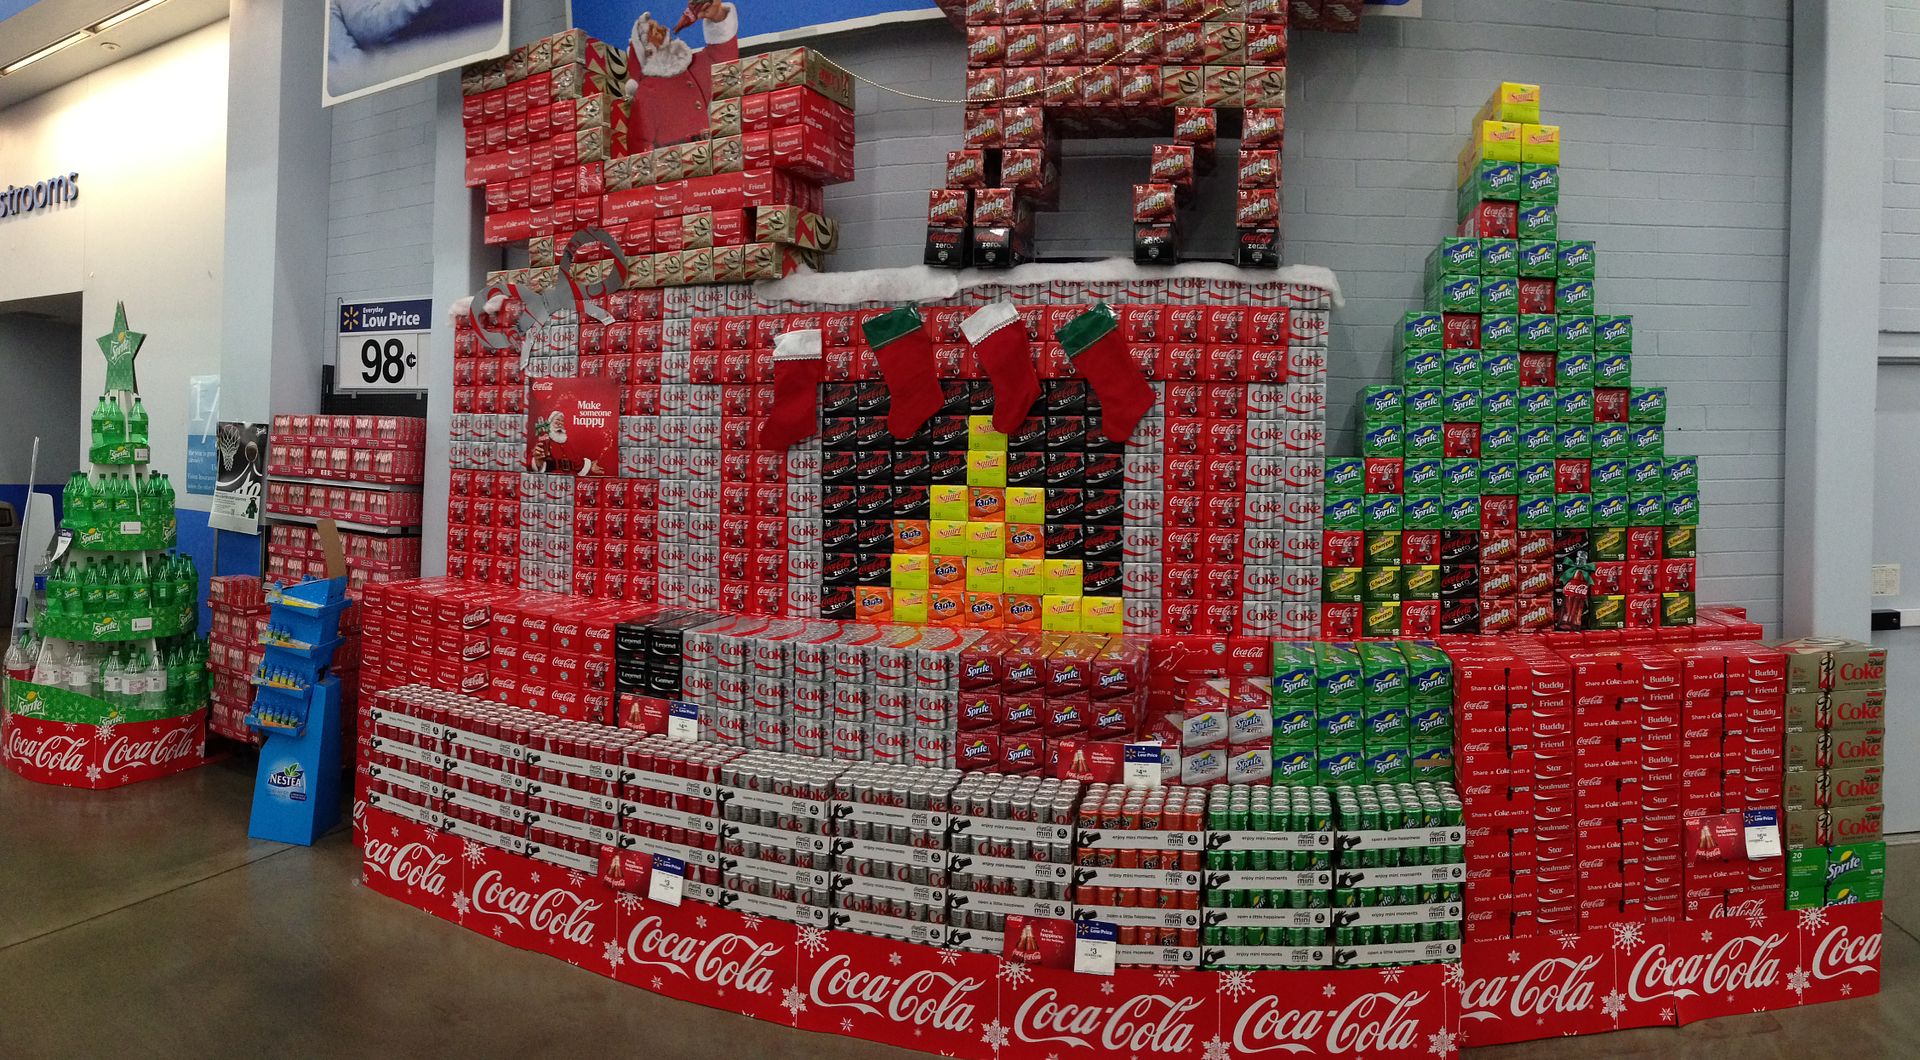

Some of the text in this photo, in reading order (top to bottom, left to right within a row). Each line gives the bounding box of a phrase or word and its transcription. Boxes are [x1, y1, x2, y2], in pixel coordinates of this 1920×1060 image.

[1491, 173, 1514, 190] Sprite
[1530, 174, 1553, 190] Sprite
[712, 187, 726, 195] Coke
[931, 199, 958, 218] Pibb
[1453, 248, 1476, 264] Sprite
[1567, 250, 1589, 266] Sprite
[1453, 283, 1476, 301] Sprite
[362, 306, 384, 314] Everyday
[362, 310, 420, 328] Low Price
[1293, 317, 1325, 331] Coke
[553, 331, 575, 342] Coke
[1414, 321, 1439, 338] Sprite
[1604, 322, 1627, 340] Sprite
[1251, 390, 1284, 403] Coke
[577, 401, 601, 410] Make
[573, 415, 604, 429] happy
[663, 455, 687, 466] Coke
[791, 459, 818, 469] Coke
[1018, 467, 1036, 478] zero
[1251, 464, 1282, 477] Coke
[1335, 468, 1359, 486] Sprite
[1671, 466, 1695, 484] Sprite
[975, 496, 998, 508] Fanta
[1012, 534, 1035, 545] Fanta
[1247, 608, 1279, 622] Coke
[94, 621, 120, 635] Sprite
[686, 640, 714, 654] Coke
[1233, 647, 1264, 659] Coca-Cola
[798, 650, 830, 665] Coke
[920, 656, 953, 672] Coke
[967, 664, 991, 679] Sprite
[1054, 670, 1079, 684] Sprite
[1650, 675, 1674, 683] Buddy
[1755, 669, 1778, 678] Buddy
[1840, 663, 1884, 681] Coke
[1283, 678, 1310, 695] Sprite
[1420, 675, 1447, 692] Sprite
[1755, 686, 1778, 694] Friend
[1650, 693, 1674, 701] Friend
[17, 698, 44, 714] Sprite
[1236, 714, 1261, 730] Sprite
[9, 728, 90, 772] Coca-Cola
[103, 723, 198, 774] Coca-Cola
[270, 773, 302, 787] NESTEA
[1538, 783, 1570, 791] Soulmate
[1838, 818, 1879, 837] Coke
[363, 838, 453, 896] ca-Cola
[1827, 856, 1861, 880] Sprite
[472, 869, 603, 946] Coca-Cola
[626, 915, 785, 995] Coca-Cola
[1627, 930, 1790, 1002] Coca-Cola
[809, 953, 989, 1033] Coca-Cola
[1460, 953, 1604, 1022] ca-Cola
[1014, 986, 1206, 1055] Coca-Cola
[1232, 989, 1431, 1055] Coca-Cola
